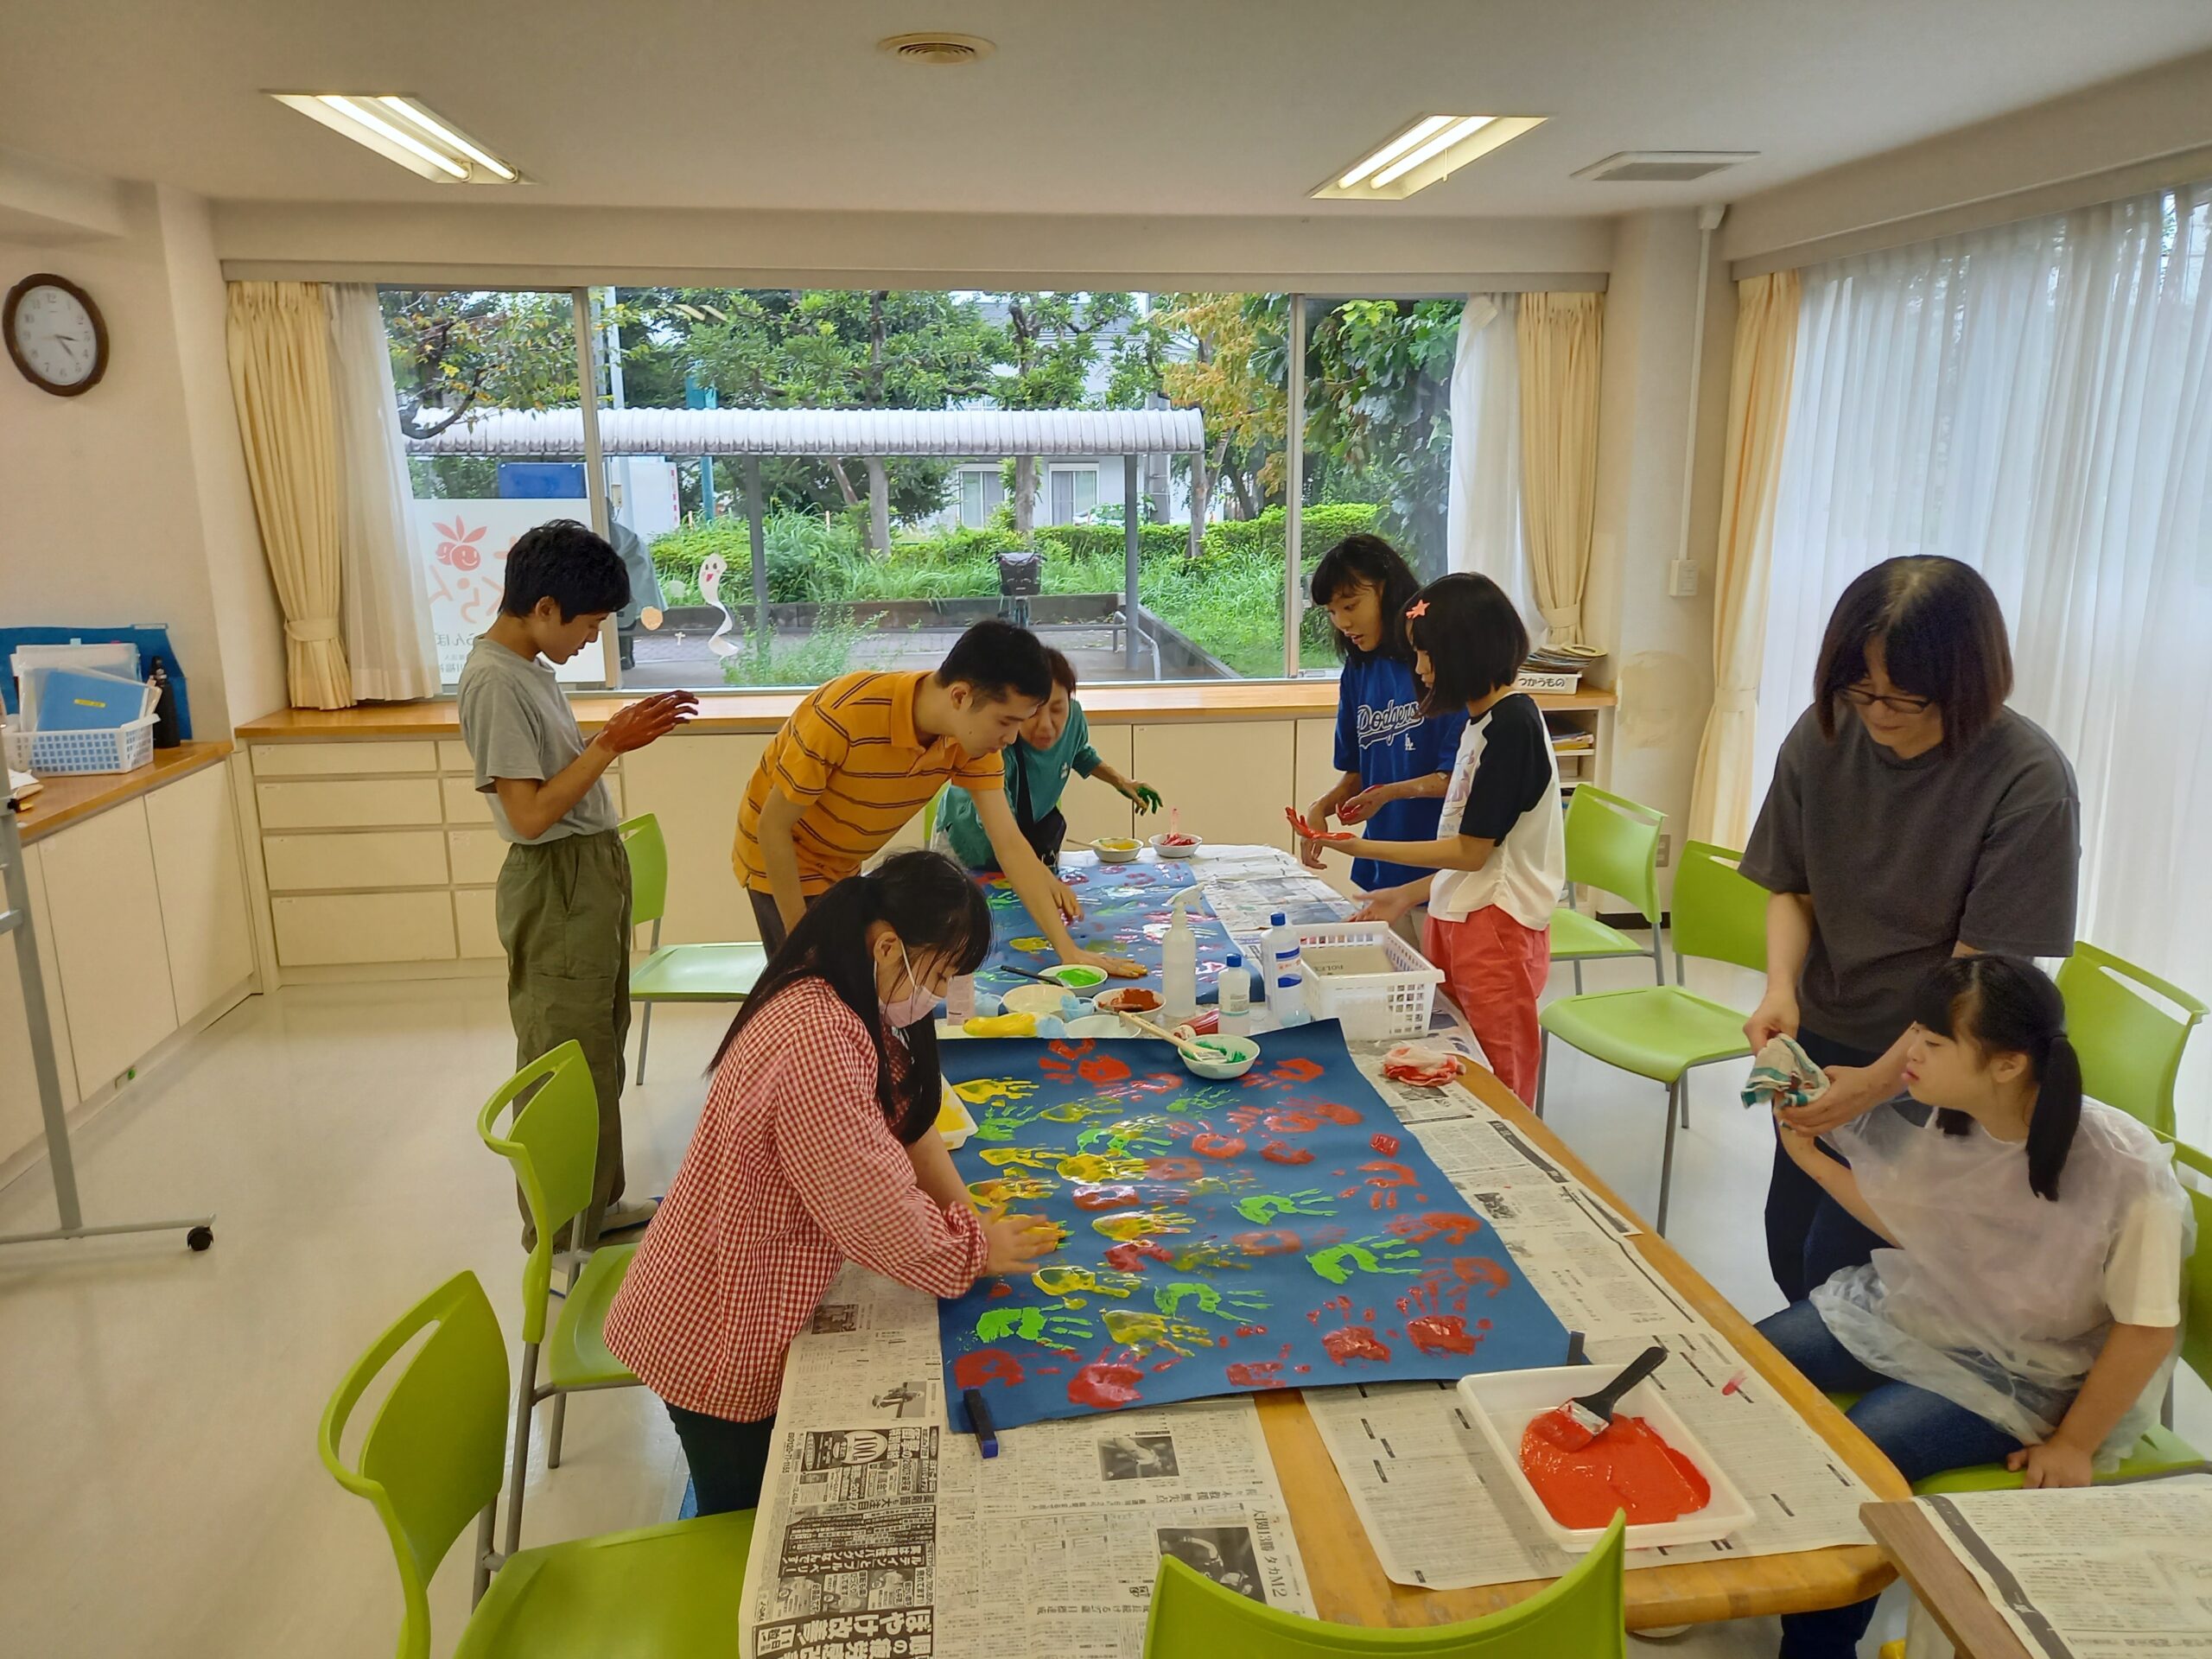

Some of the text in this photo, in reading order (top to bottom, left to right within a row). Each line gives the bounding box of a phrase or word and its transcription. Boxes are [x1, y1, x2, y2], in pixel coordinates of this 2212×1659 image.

[1518, 677, 1565, 688] つかうもの
[1357, 699, 1421, 747] Dodgers
